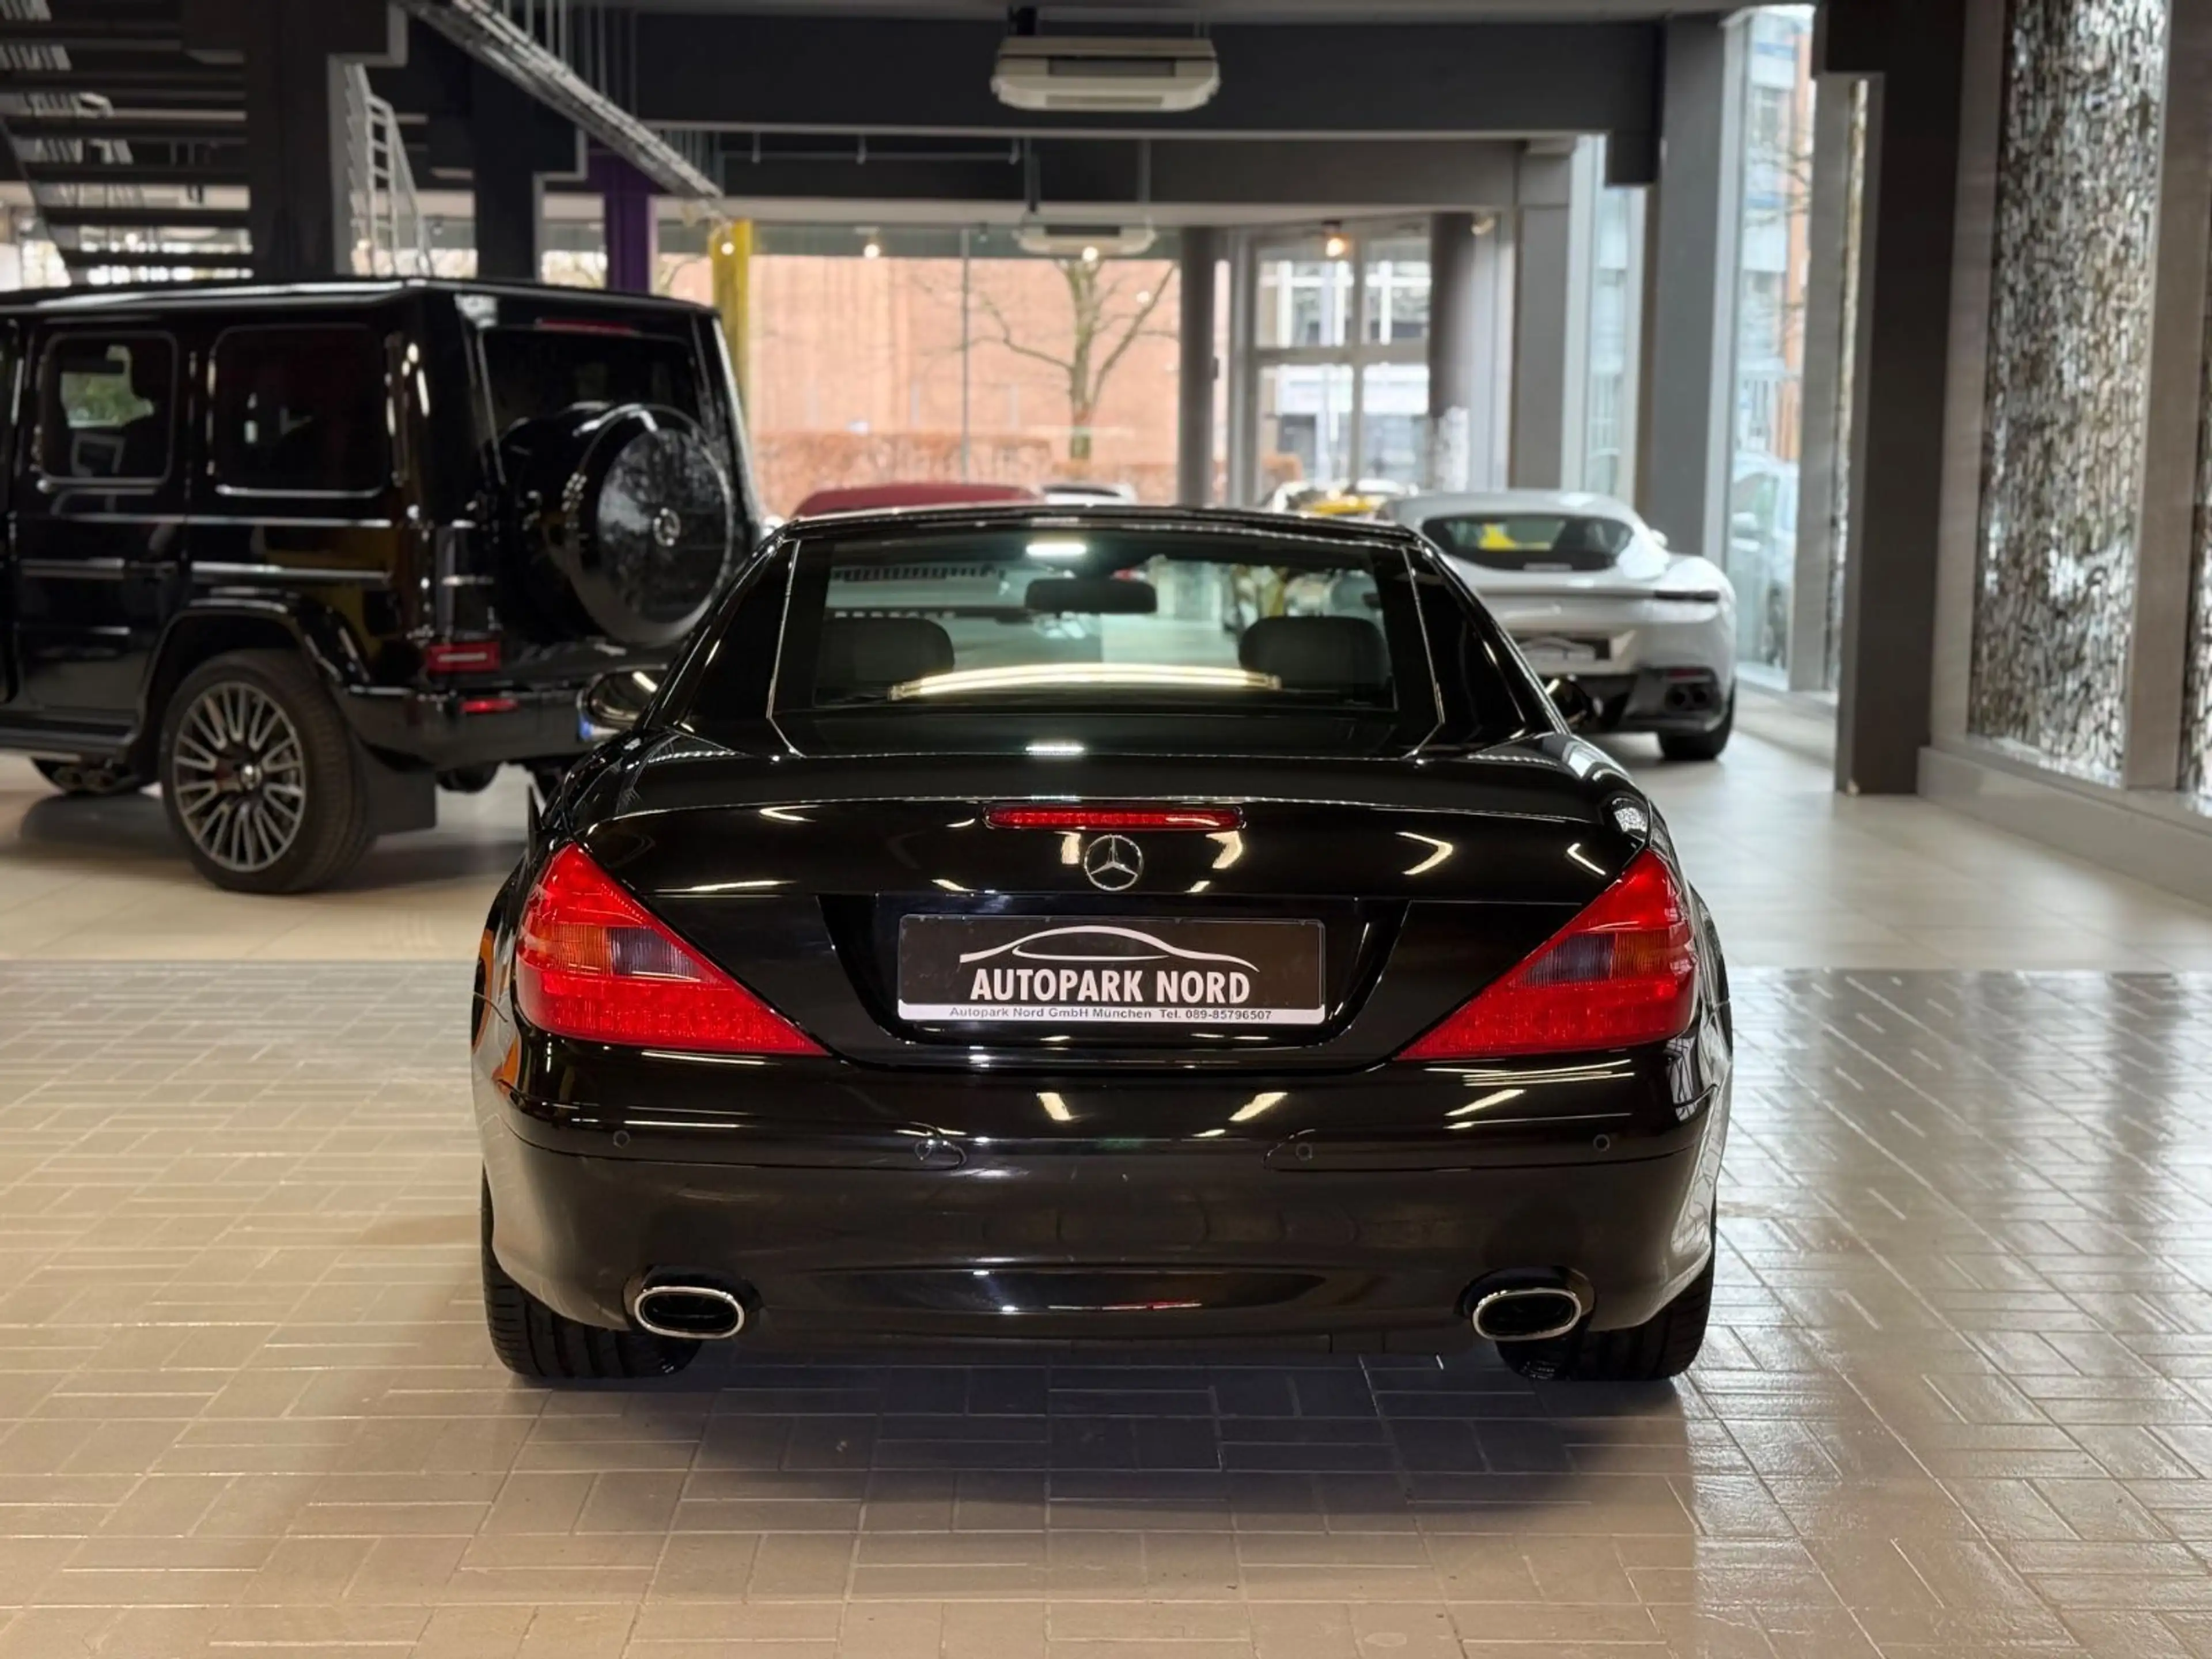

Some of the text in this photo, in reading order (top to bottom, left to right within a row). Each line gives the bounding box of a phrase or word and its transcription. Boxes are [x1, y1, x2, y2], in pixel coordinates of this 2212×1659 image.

[969, 968, 1250, 1004] AUTOPARK NORD
[950, 1007, 1009, 1019] Autopark
[1013, 1007, 1044, 1018] Nord
[1048, 1007, 1089, 1018] GmbH
[1160, 1009, 1181, 1018] Tel.
[1185, 1009, 1272, 1020] 089-85796507
